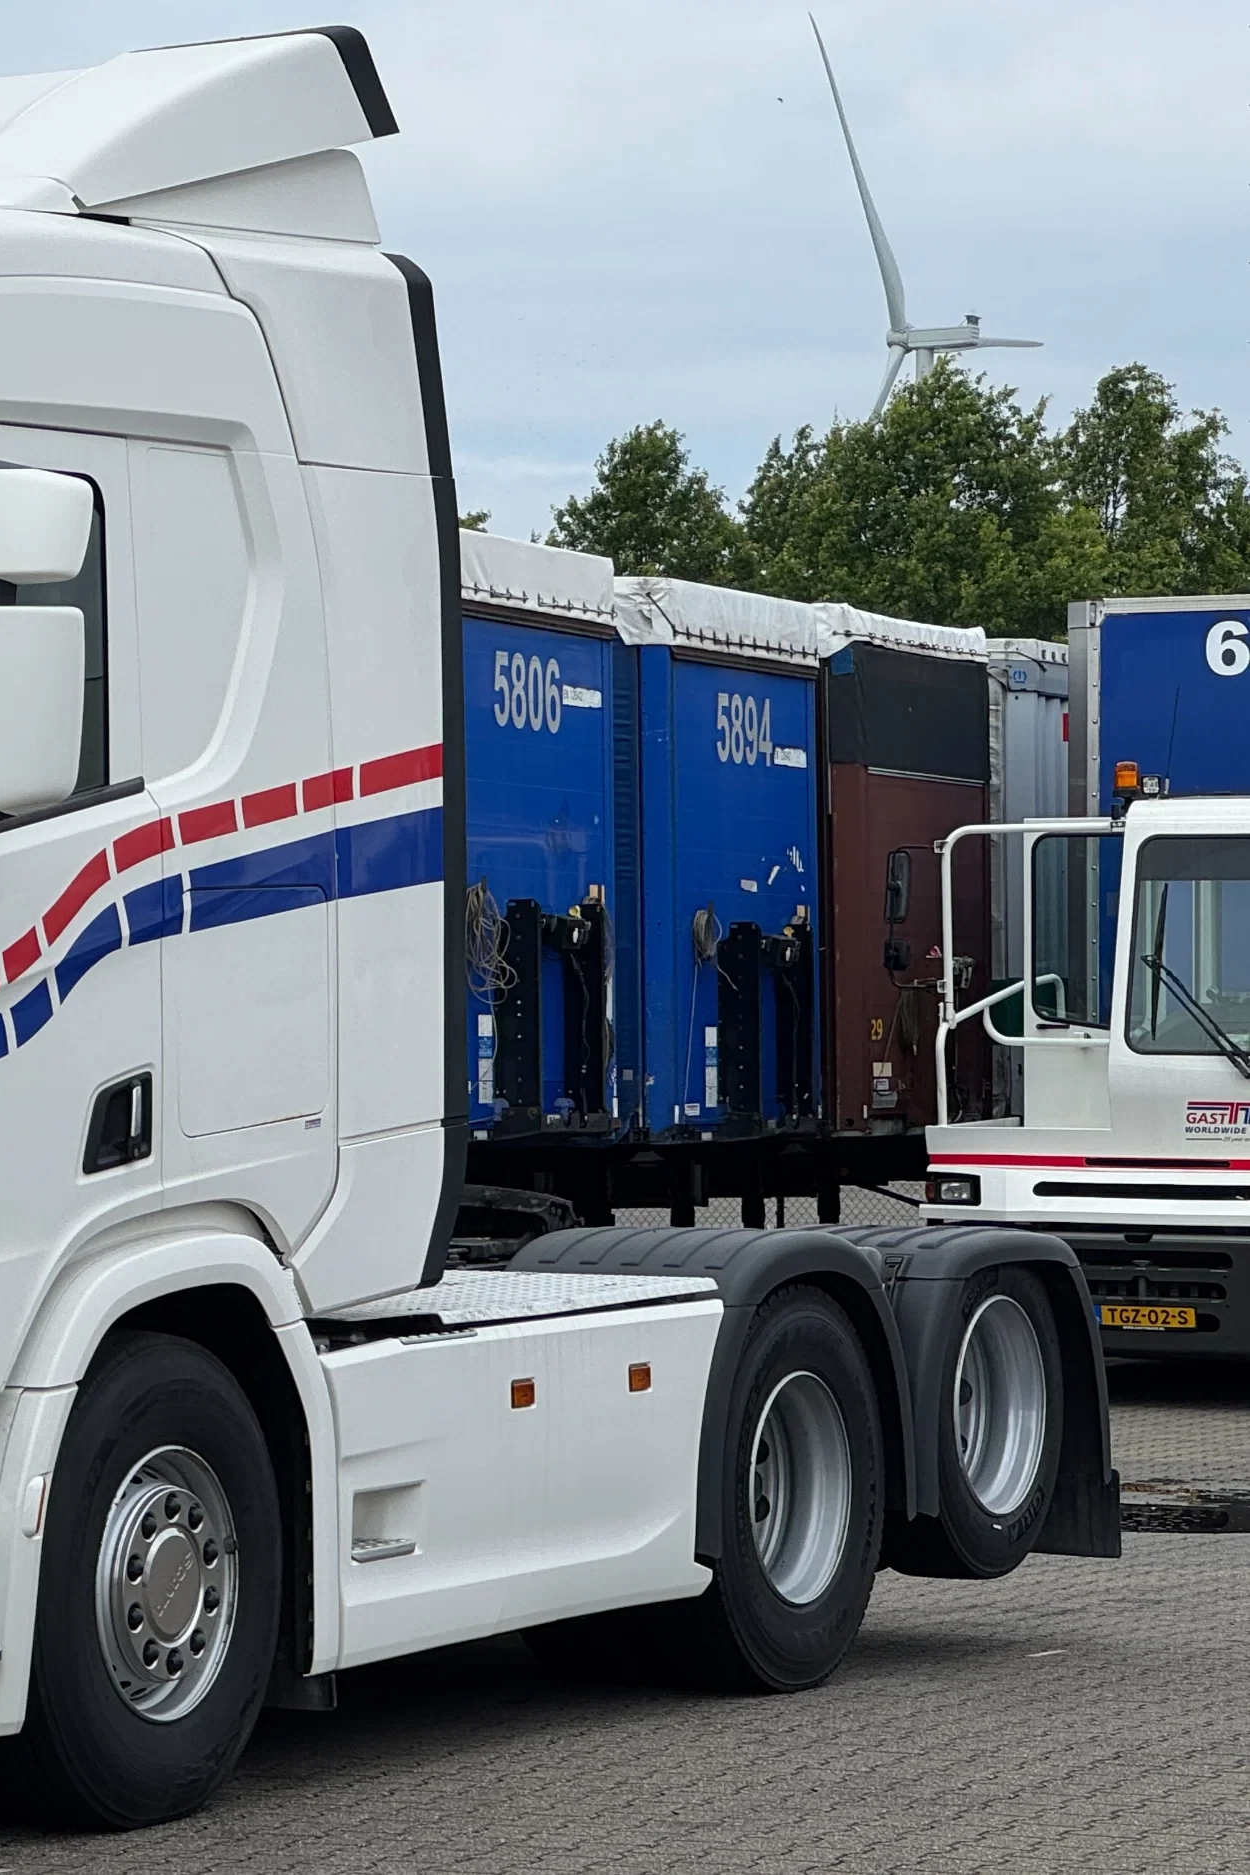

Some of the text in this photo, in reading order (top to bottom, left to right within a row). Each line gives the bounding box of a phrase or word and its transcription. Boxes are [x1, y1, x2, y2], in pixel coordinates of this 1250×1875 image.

[494, 650, 561, 734] 5806
[716, 692, 773, 767] 5894
[871, 1019, 883, 1041] 29
[1185, 1126, 1248, 1135] WORLDWIDE
[1107, 1307, 1189, 1326] TGZ-02-S
